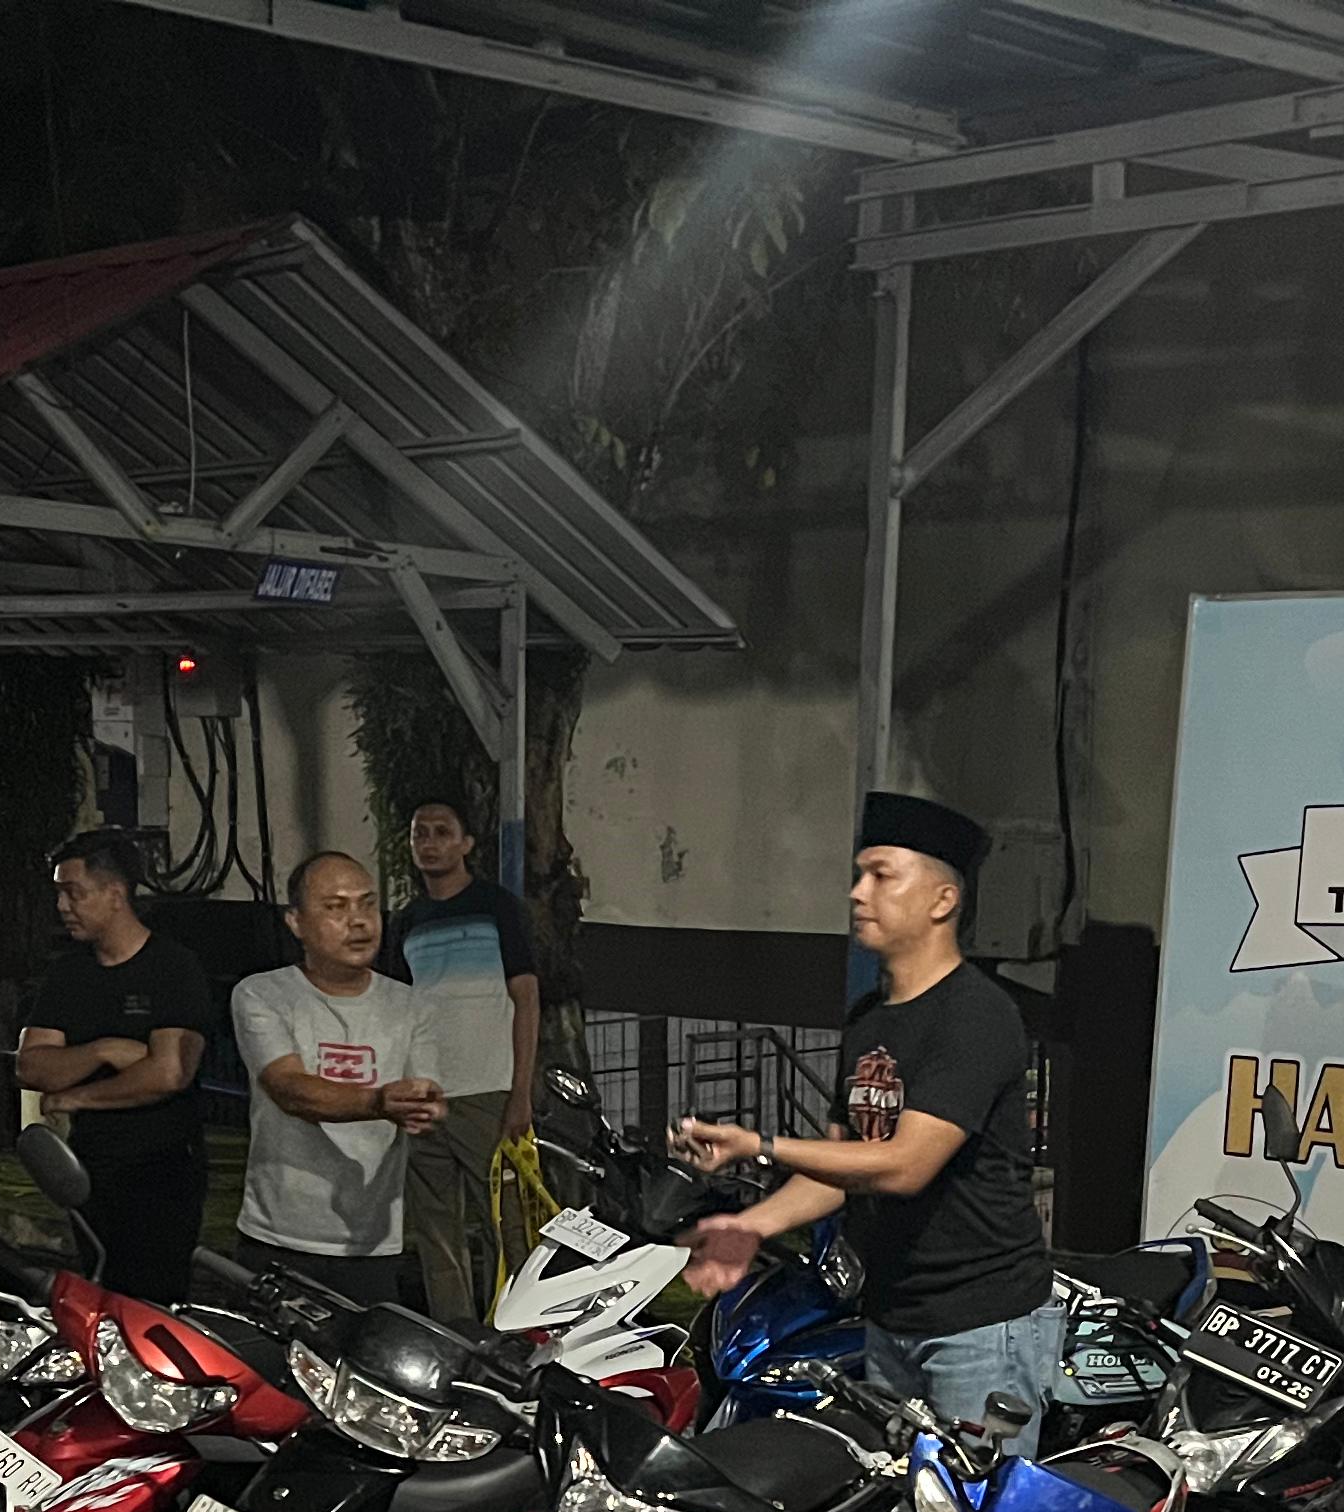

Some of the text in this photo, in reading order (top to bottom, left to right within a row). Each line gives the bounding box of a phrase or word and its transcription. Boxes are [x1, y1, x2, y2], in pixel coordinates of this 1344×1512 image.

[1207, 1311, 1337, 1380] BP 3717 CT
